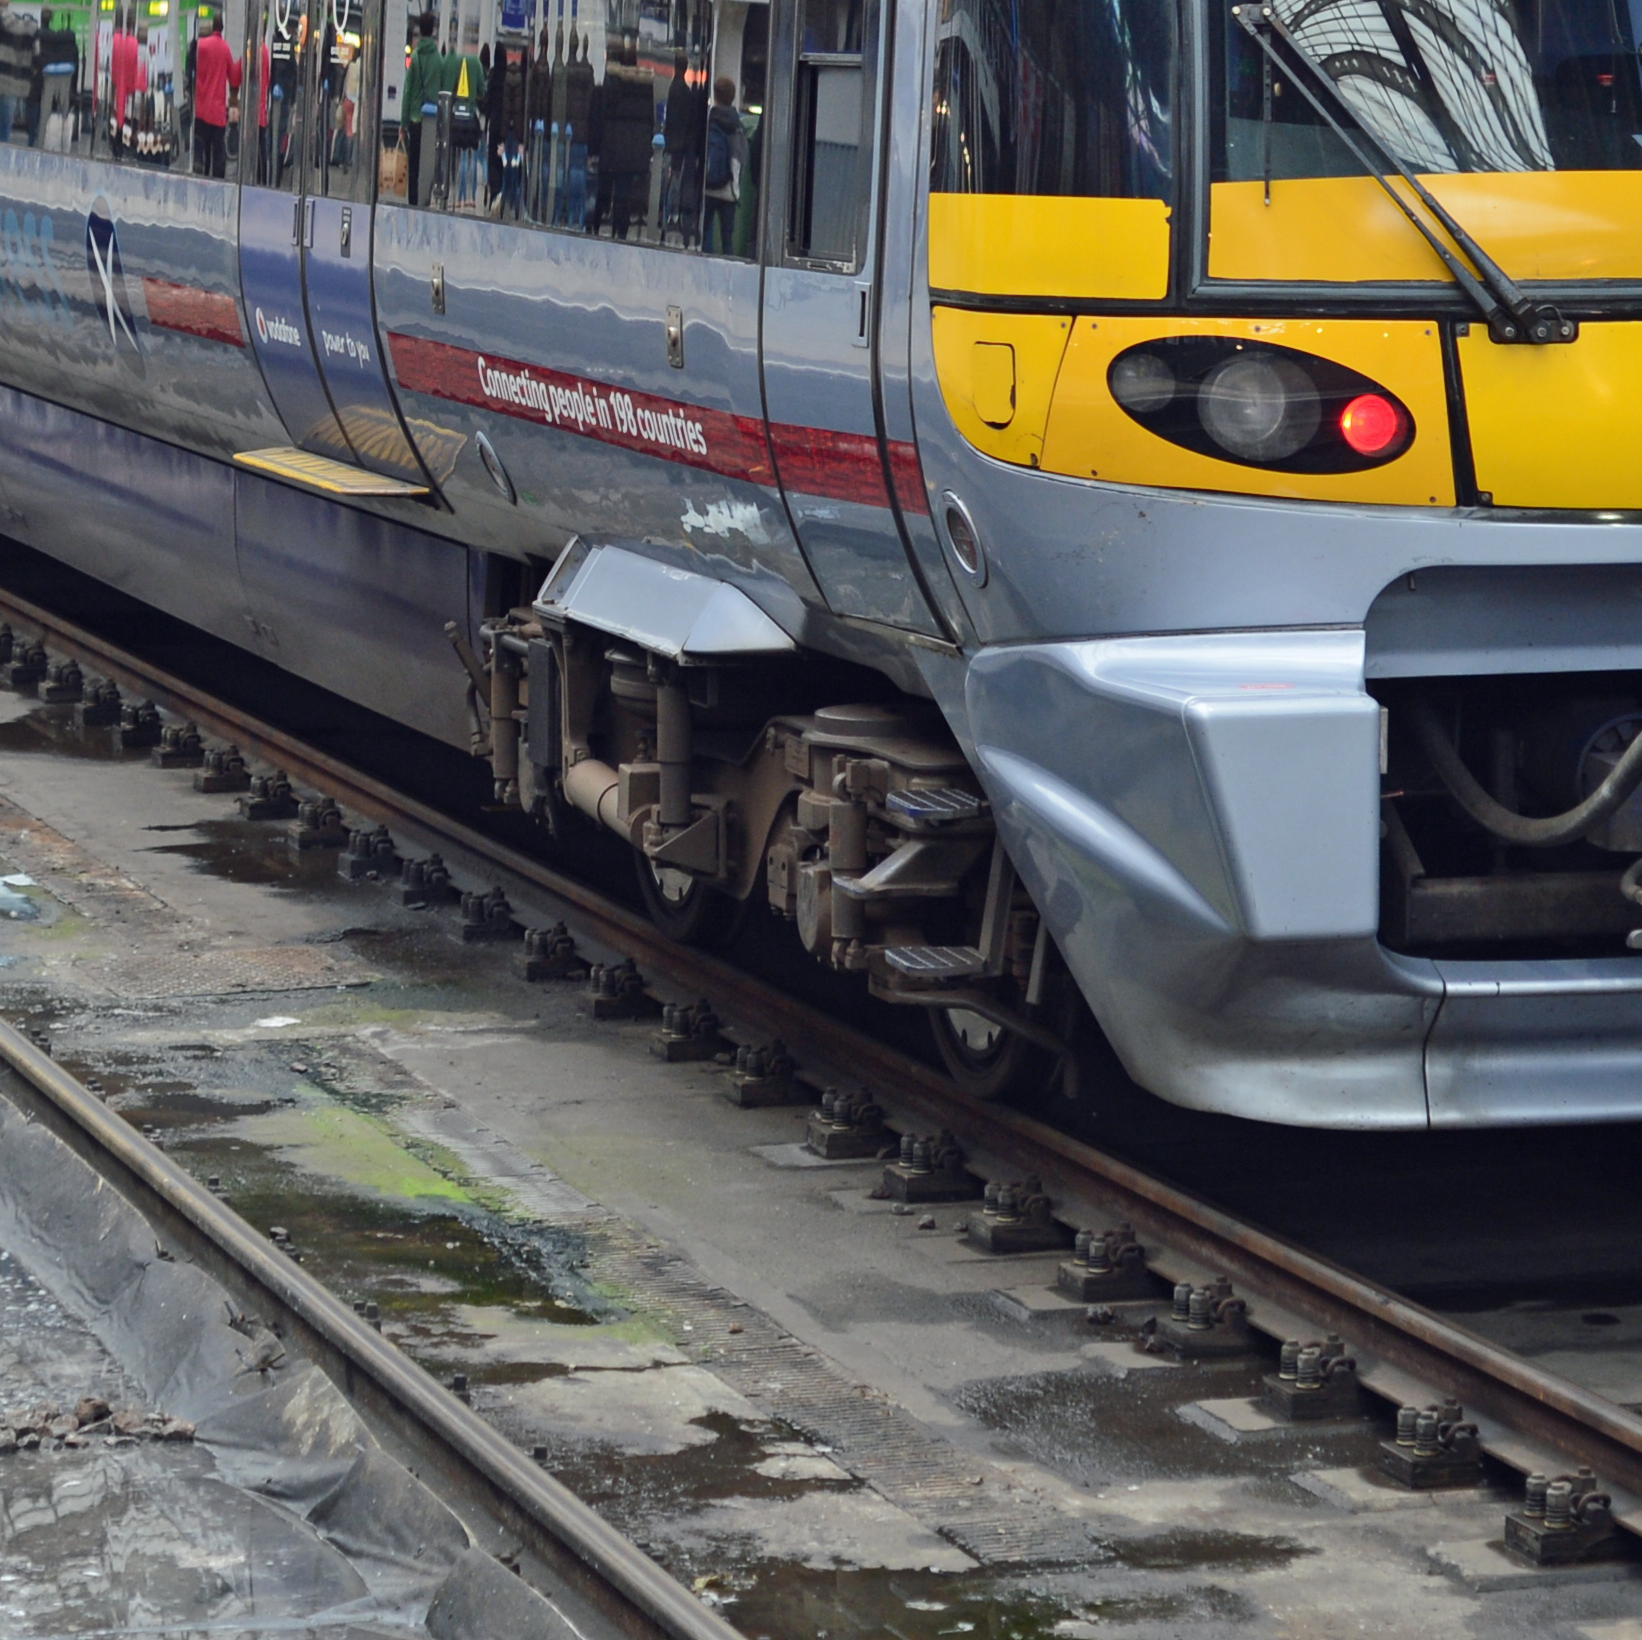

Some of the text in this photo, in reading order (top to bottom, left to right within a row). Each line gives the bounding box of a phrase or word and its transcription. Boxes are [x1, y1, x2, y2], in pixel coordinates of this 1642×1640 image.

[266, 316, 301, 347] vodafone
[322, 330, 370, 369] power to you
[477, 355, 708, 455] Connecting people in 198 countries
